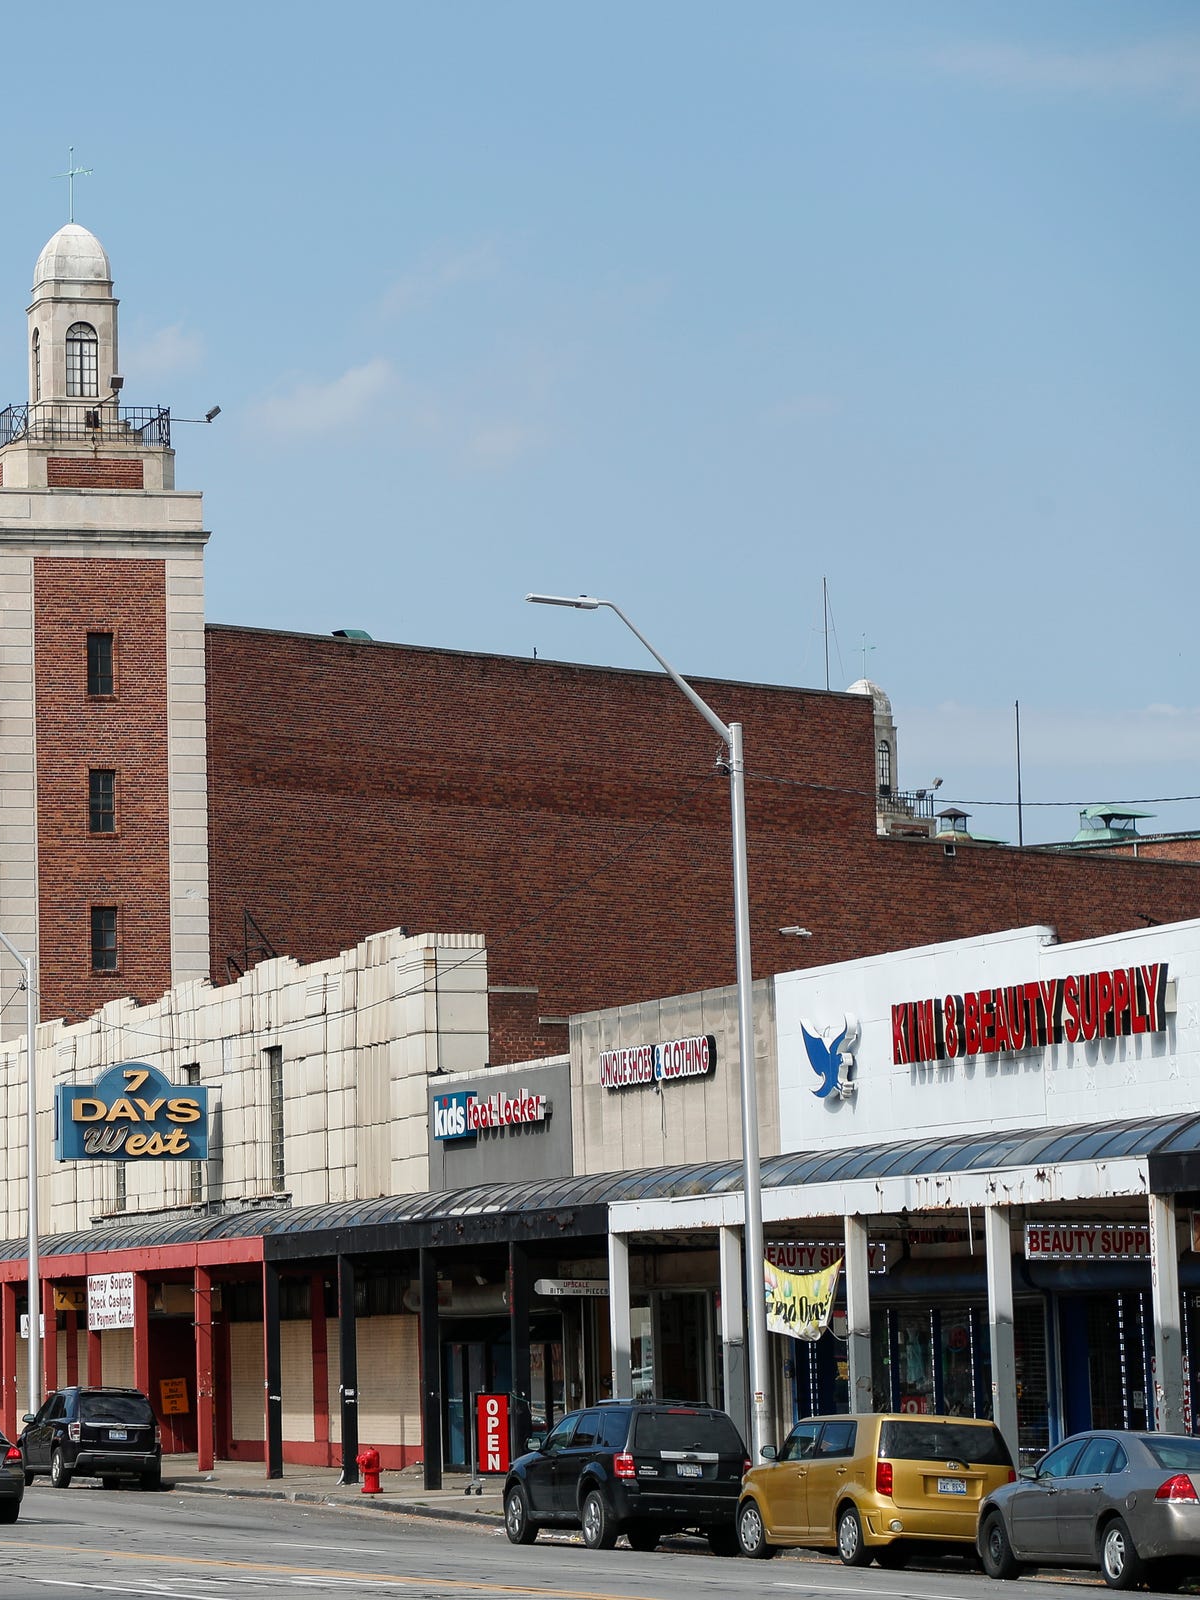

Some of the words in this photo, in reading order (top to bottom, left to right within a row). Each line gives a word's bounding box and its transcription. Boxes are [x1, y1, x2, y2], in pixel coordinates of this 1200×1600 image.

[891, 998, 937, 1065] KIM
[963, 978, 1059, 1056] BEAUTY
[1063, 962, 1161, 1044] SUPPLY
[600, 1050, 628, 1088] UNIQUE
[628, 1045, 652, 1083] SHOES
[655, 1045, 662, 1079] &
[663, 1037, 709, 1078] CLOTHING
[123, 1069, 150, 1092] 7
[71, 1097, 201, 1123] DAYS
[434, 1097, 465, 1137] kids
[467, 1096, 497, 1130] Foot
[497, 1088, 545, 1126] Locker
[83, 1125, 190, 1156] West
[1029, 1230, 1097, 1253] BEAUTY
[1101, 1231, 1150, 1254] SUPP
[1150, 1205, 1158, 1288] 15340
[763, 1247, 817, 1267] EAUTY
[820, 1247, 877, 1267] SUY
[88, 1278, 107, 1293] Money
[110, 1275, 132, 1290] Source
[57, 1291, 67, 1303] 7
[90, 1295, 106, 1309] Check
[109, 1295, 131, 1309] Cashing
[96, 1312, 117, 1328] Payment
[118, 1310, 134, 1324] Center
[486, 1399, 501, 1471] OPEN
